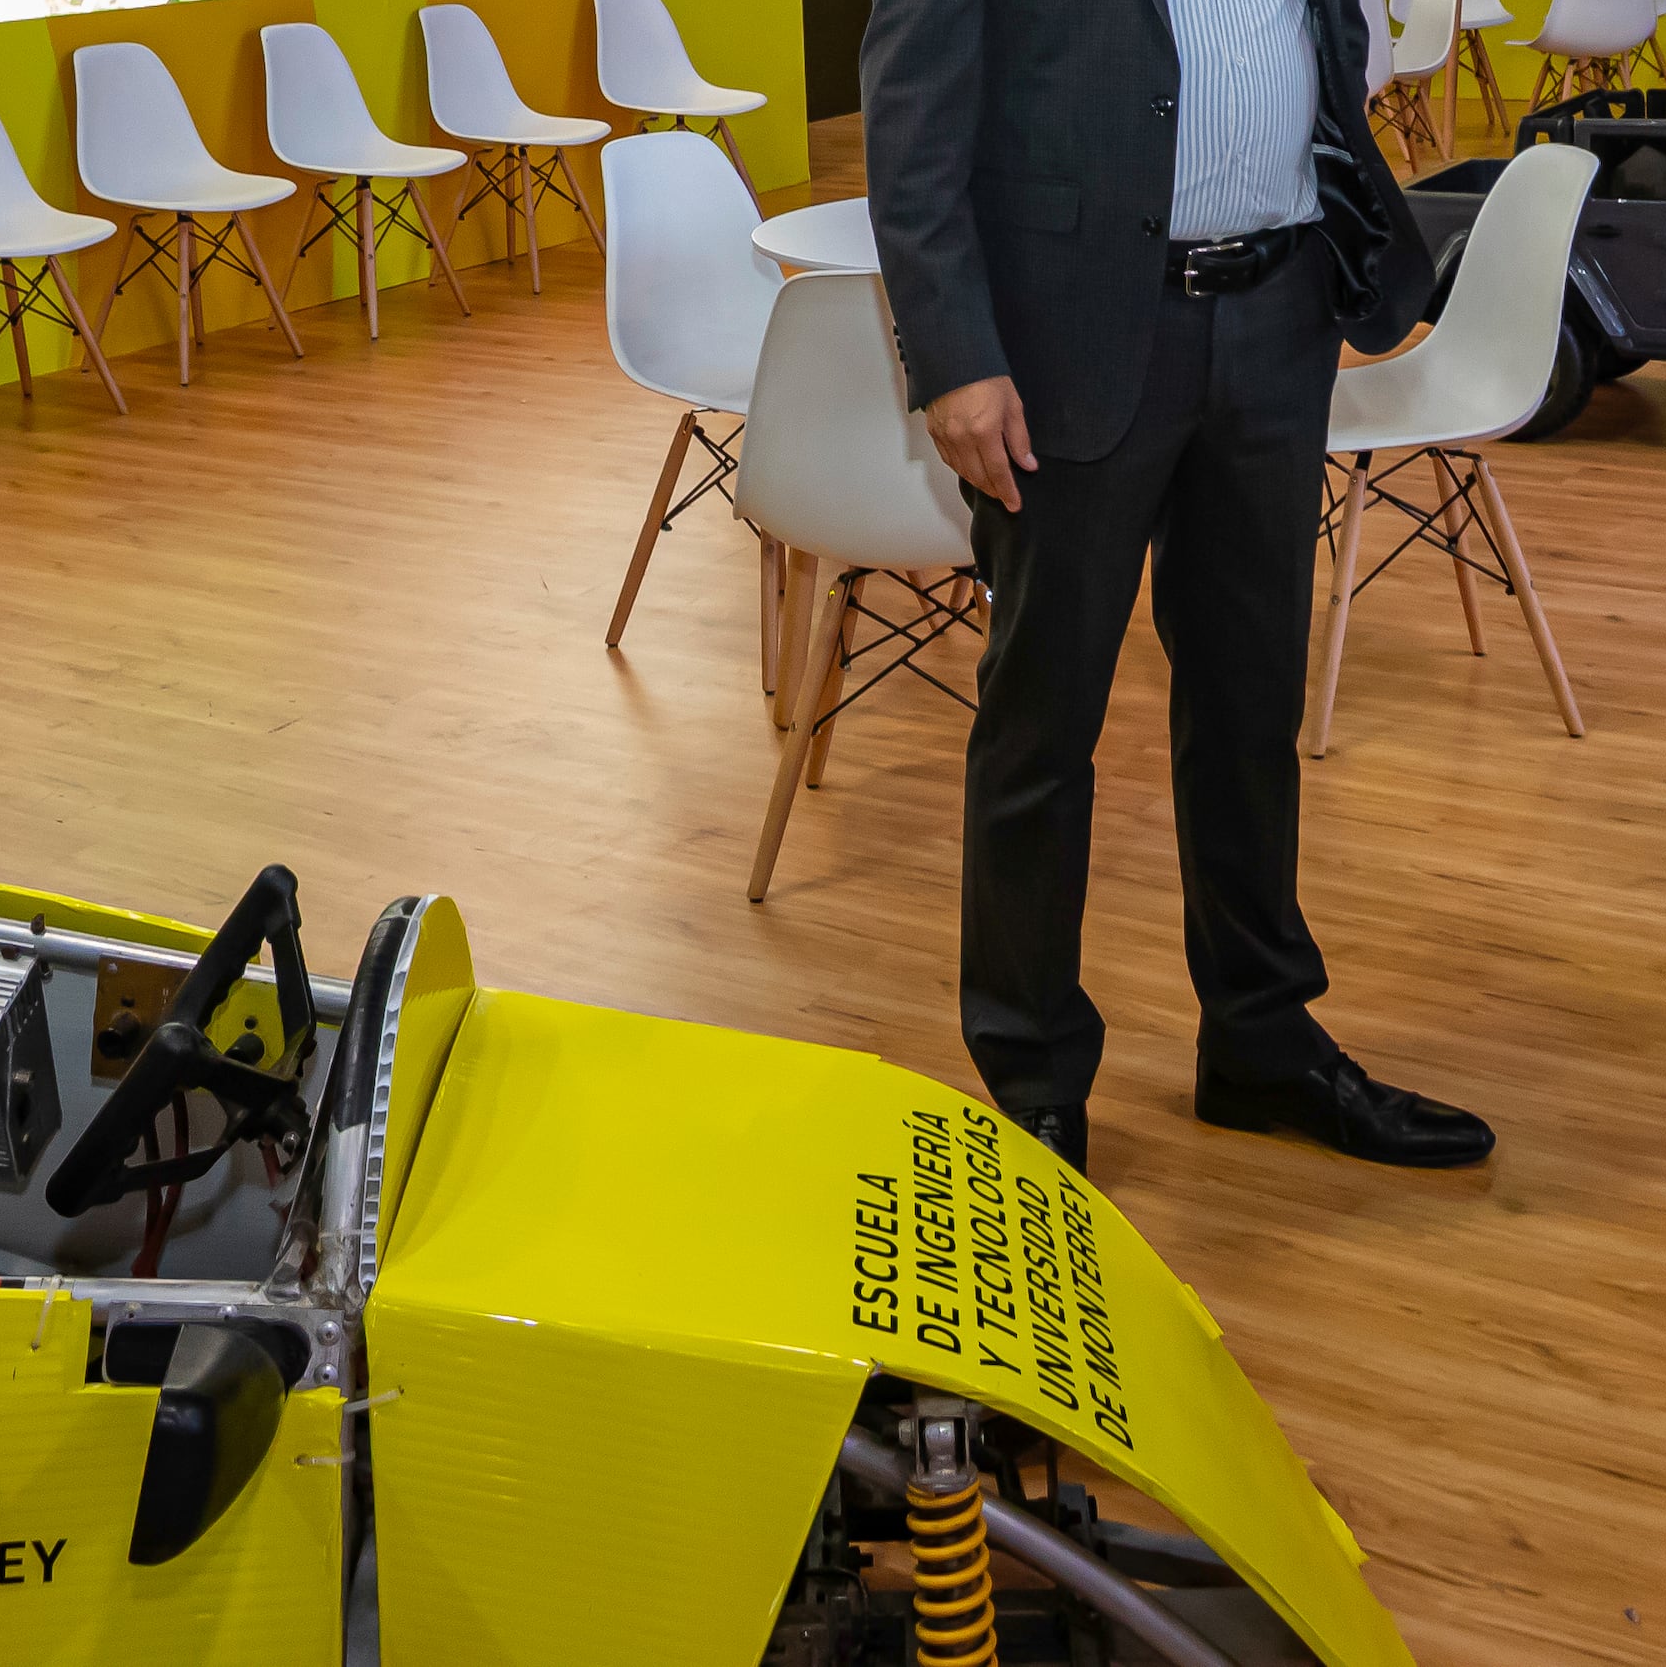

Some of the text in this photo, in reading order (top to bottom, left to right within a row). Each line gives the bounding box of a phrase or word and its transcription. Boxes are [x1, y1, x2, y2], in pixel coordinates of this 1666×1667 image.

[852, 1172, 899, 1335] ESCUELA
[902, 1110, 961, 1356] DE INGENIERÍA
[955, 1106, 1022, 1375] Y TECNOLOGÍAS
[1015, 1175, 1080, 1411] UNIVERSIDAD
[1057, 1168, 1134, 1452] DE MONTERREY
